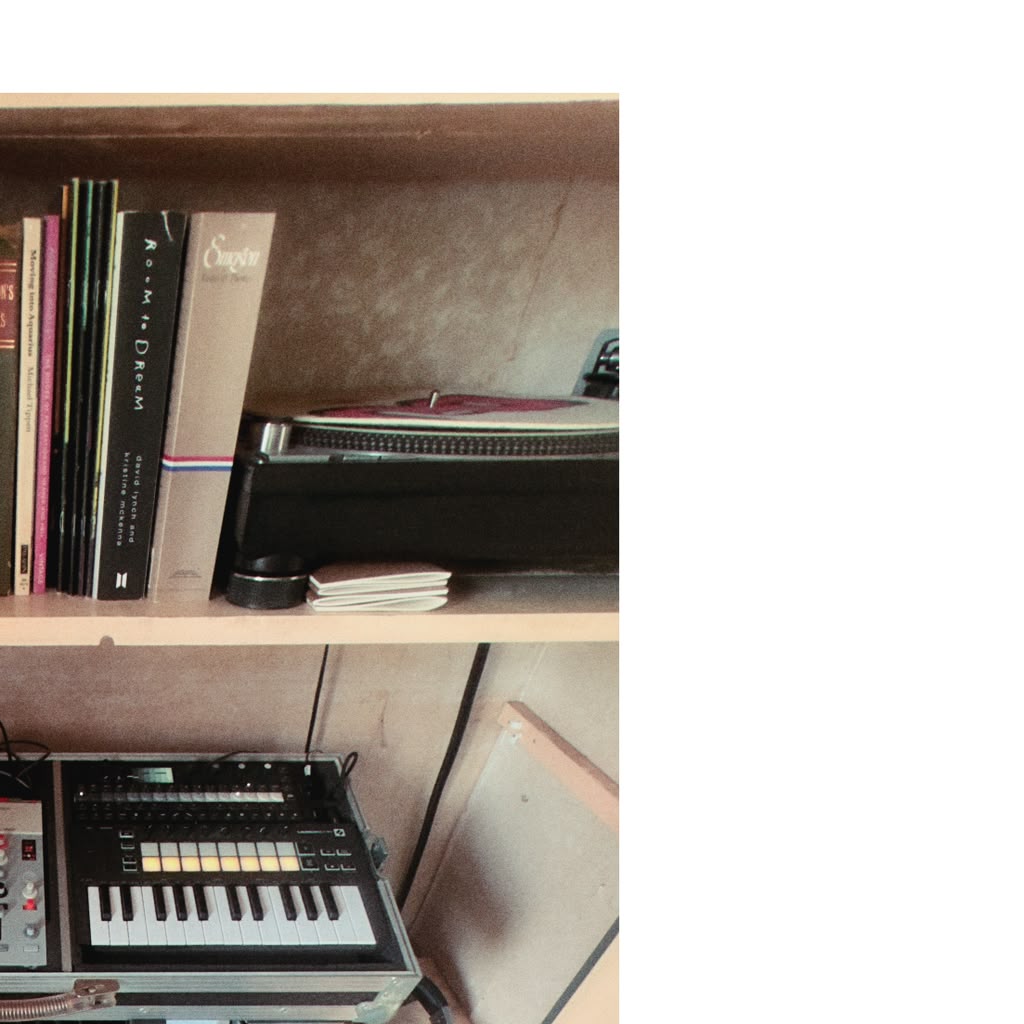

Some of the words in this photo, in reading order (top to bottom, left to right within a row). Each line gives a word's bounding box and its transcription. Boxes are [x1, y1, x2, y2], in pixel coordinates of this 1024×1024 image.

[29, 249, 37, 289] Moving
[26, 313, 35, 357] Aquarius
[119, 451, 130, 495] kristine
[132, 455, 142, 486] david
[115, 500, 126, 546] mckenna
[128, 490, 139, 520] lynch
[128, 524, 136, 543] and
